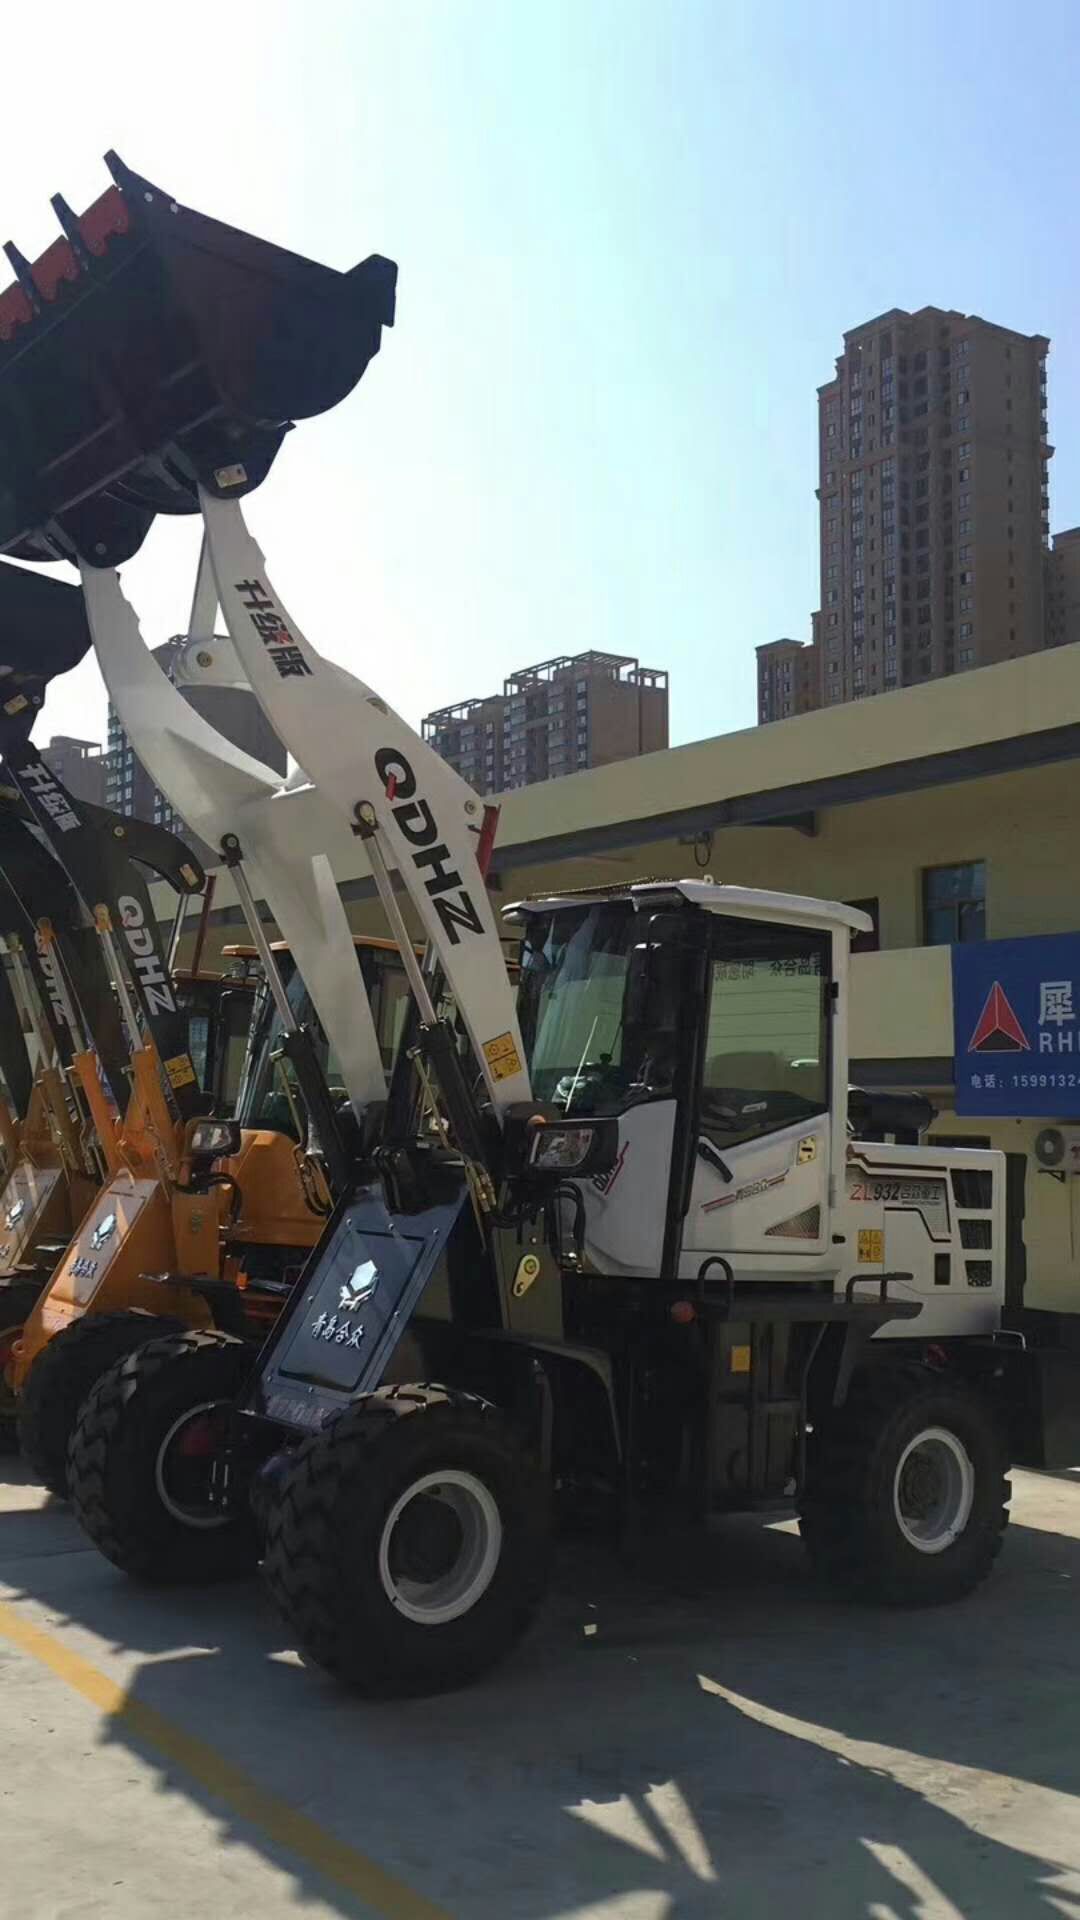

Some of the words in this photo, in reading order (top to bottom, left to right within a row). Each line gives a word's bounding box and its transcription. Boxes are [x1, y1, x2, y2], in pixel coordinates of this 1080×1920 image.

[235, 579, 313, 678] 升级版
[375, 747, 485, 945] QDHZ
[118, 895, 176, 1016] QDHZ
[1038, 980, 1076, 1026] 犀
[1039, 1031, 1080, 1053] RH
[849, 1182, 900, 1200] ZL932
[311, 1312, 364, 1350] 青岛合众
